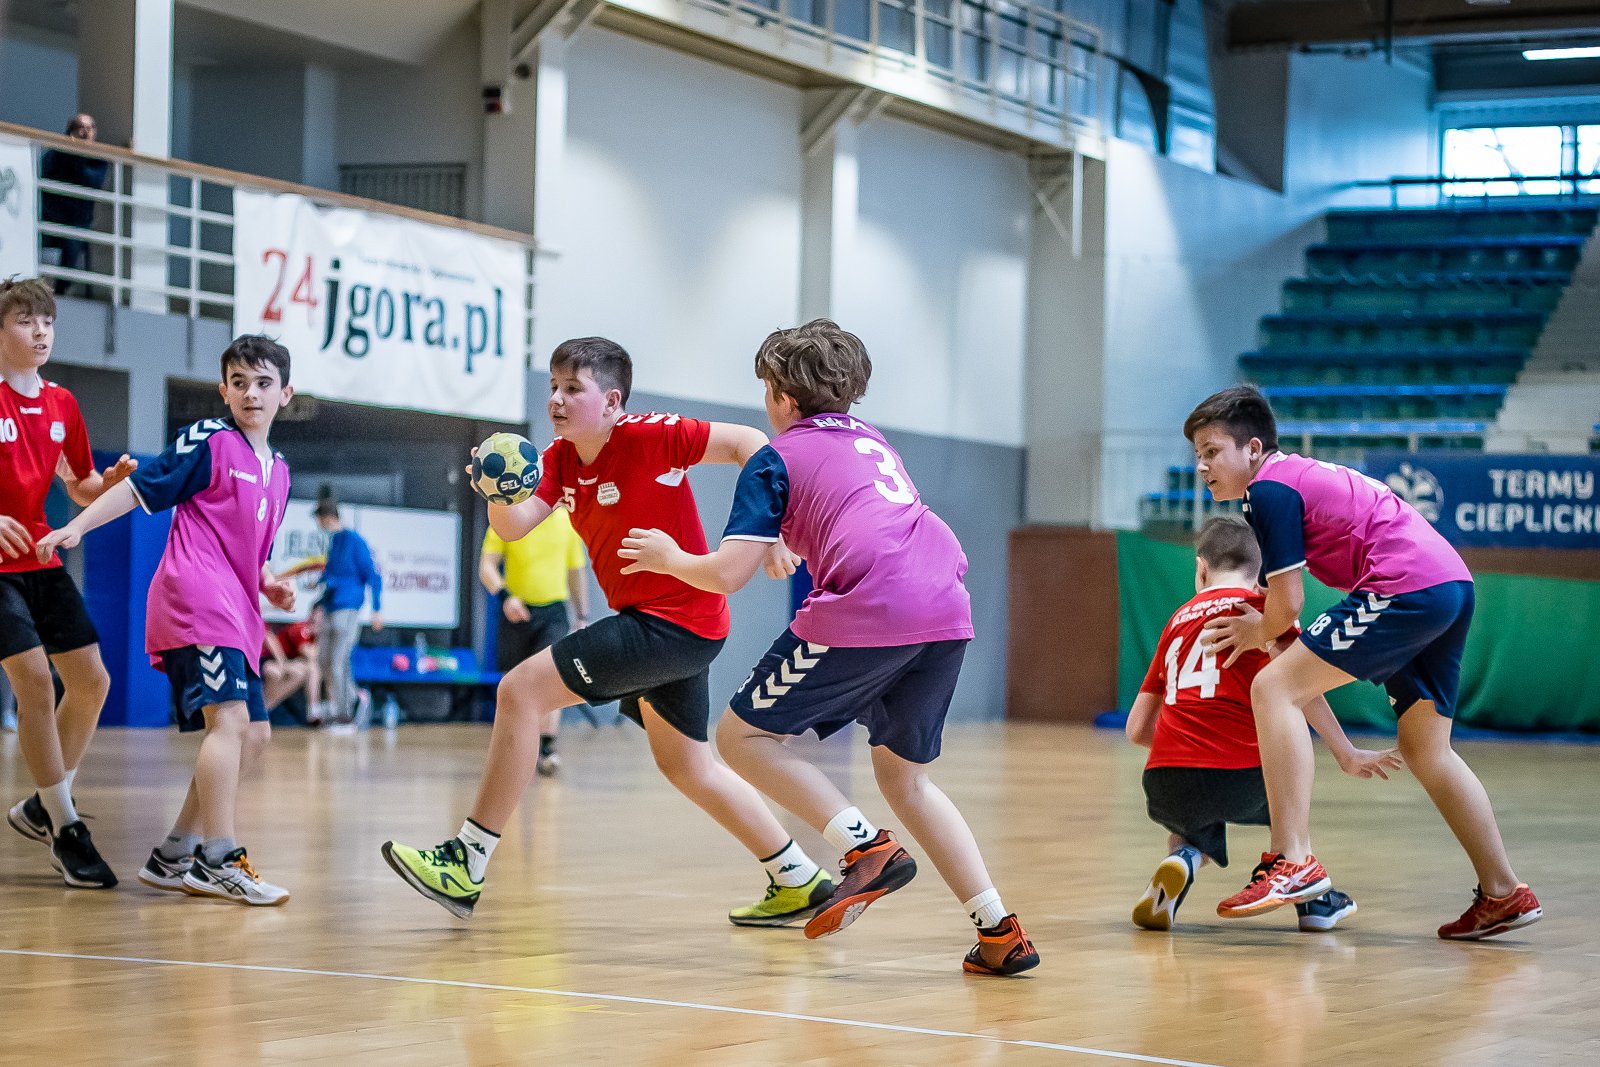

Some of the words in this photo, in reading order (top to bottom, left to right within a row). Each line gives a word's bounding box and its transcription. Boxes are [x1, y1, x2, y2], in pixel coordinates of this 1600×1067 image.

[261, 247, 505, 373] 24jgora.pl
[854, 437, 915, 504] 3
[1488, 468, 1595, 500] TERMY
[257, 497, 269, 522] 8
[1307, 612, 1332, 636] 18
[1164, 635, 1220, 705] 14
